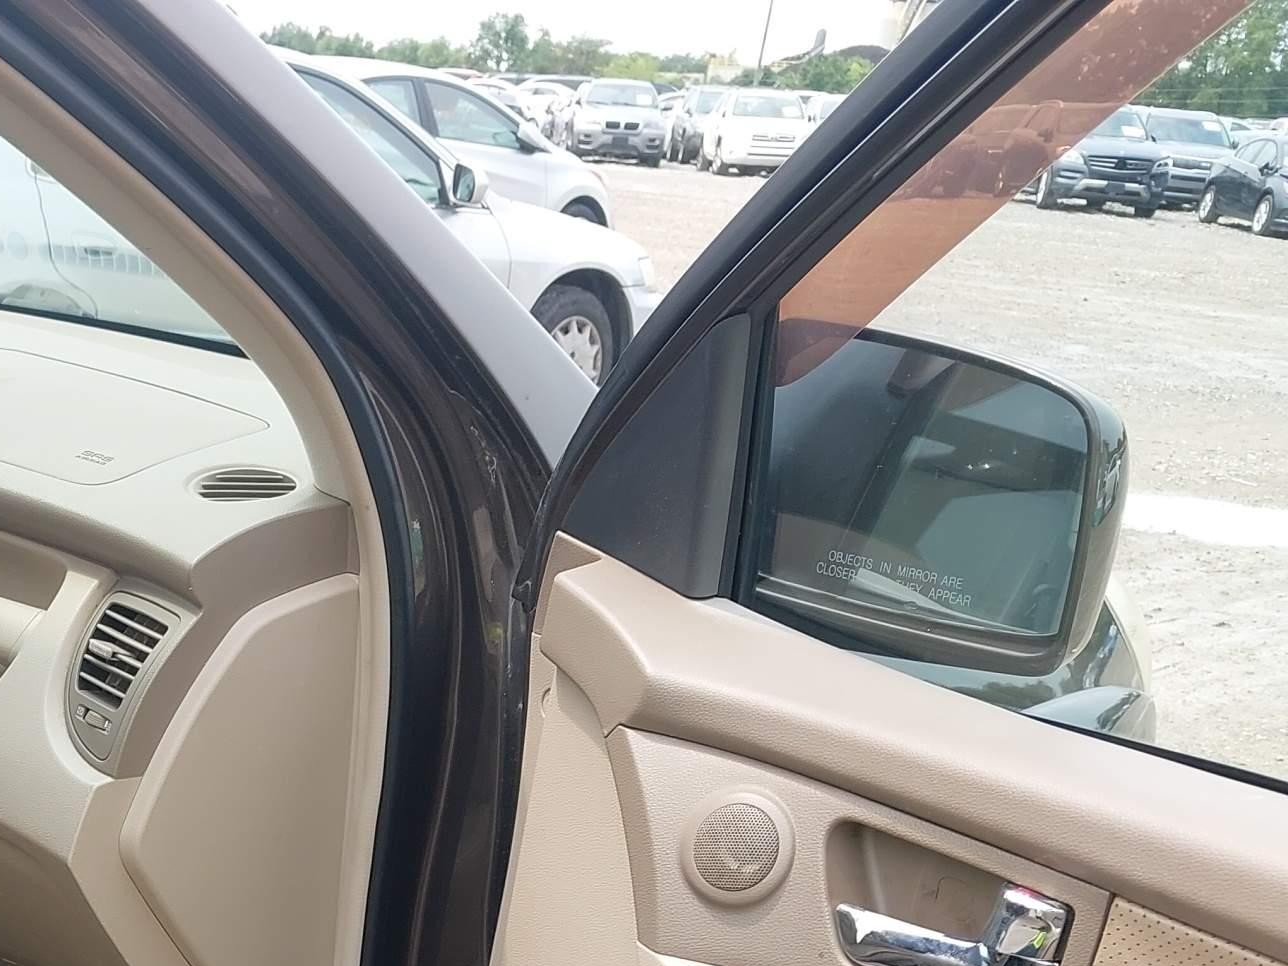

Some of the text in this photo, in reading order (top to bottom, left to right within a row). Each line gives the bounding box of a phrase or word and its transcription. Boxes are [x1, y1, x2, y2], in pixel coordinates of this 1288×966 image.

[816, 561, 857, 581] CLOSER
[928, 587, 972, 607] APPEAR
[828, 550, 964, 590] OBJECTS IN MIRROR ARE
